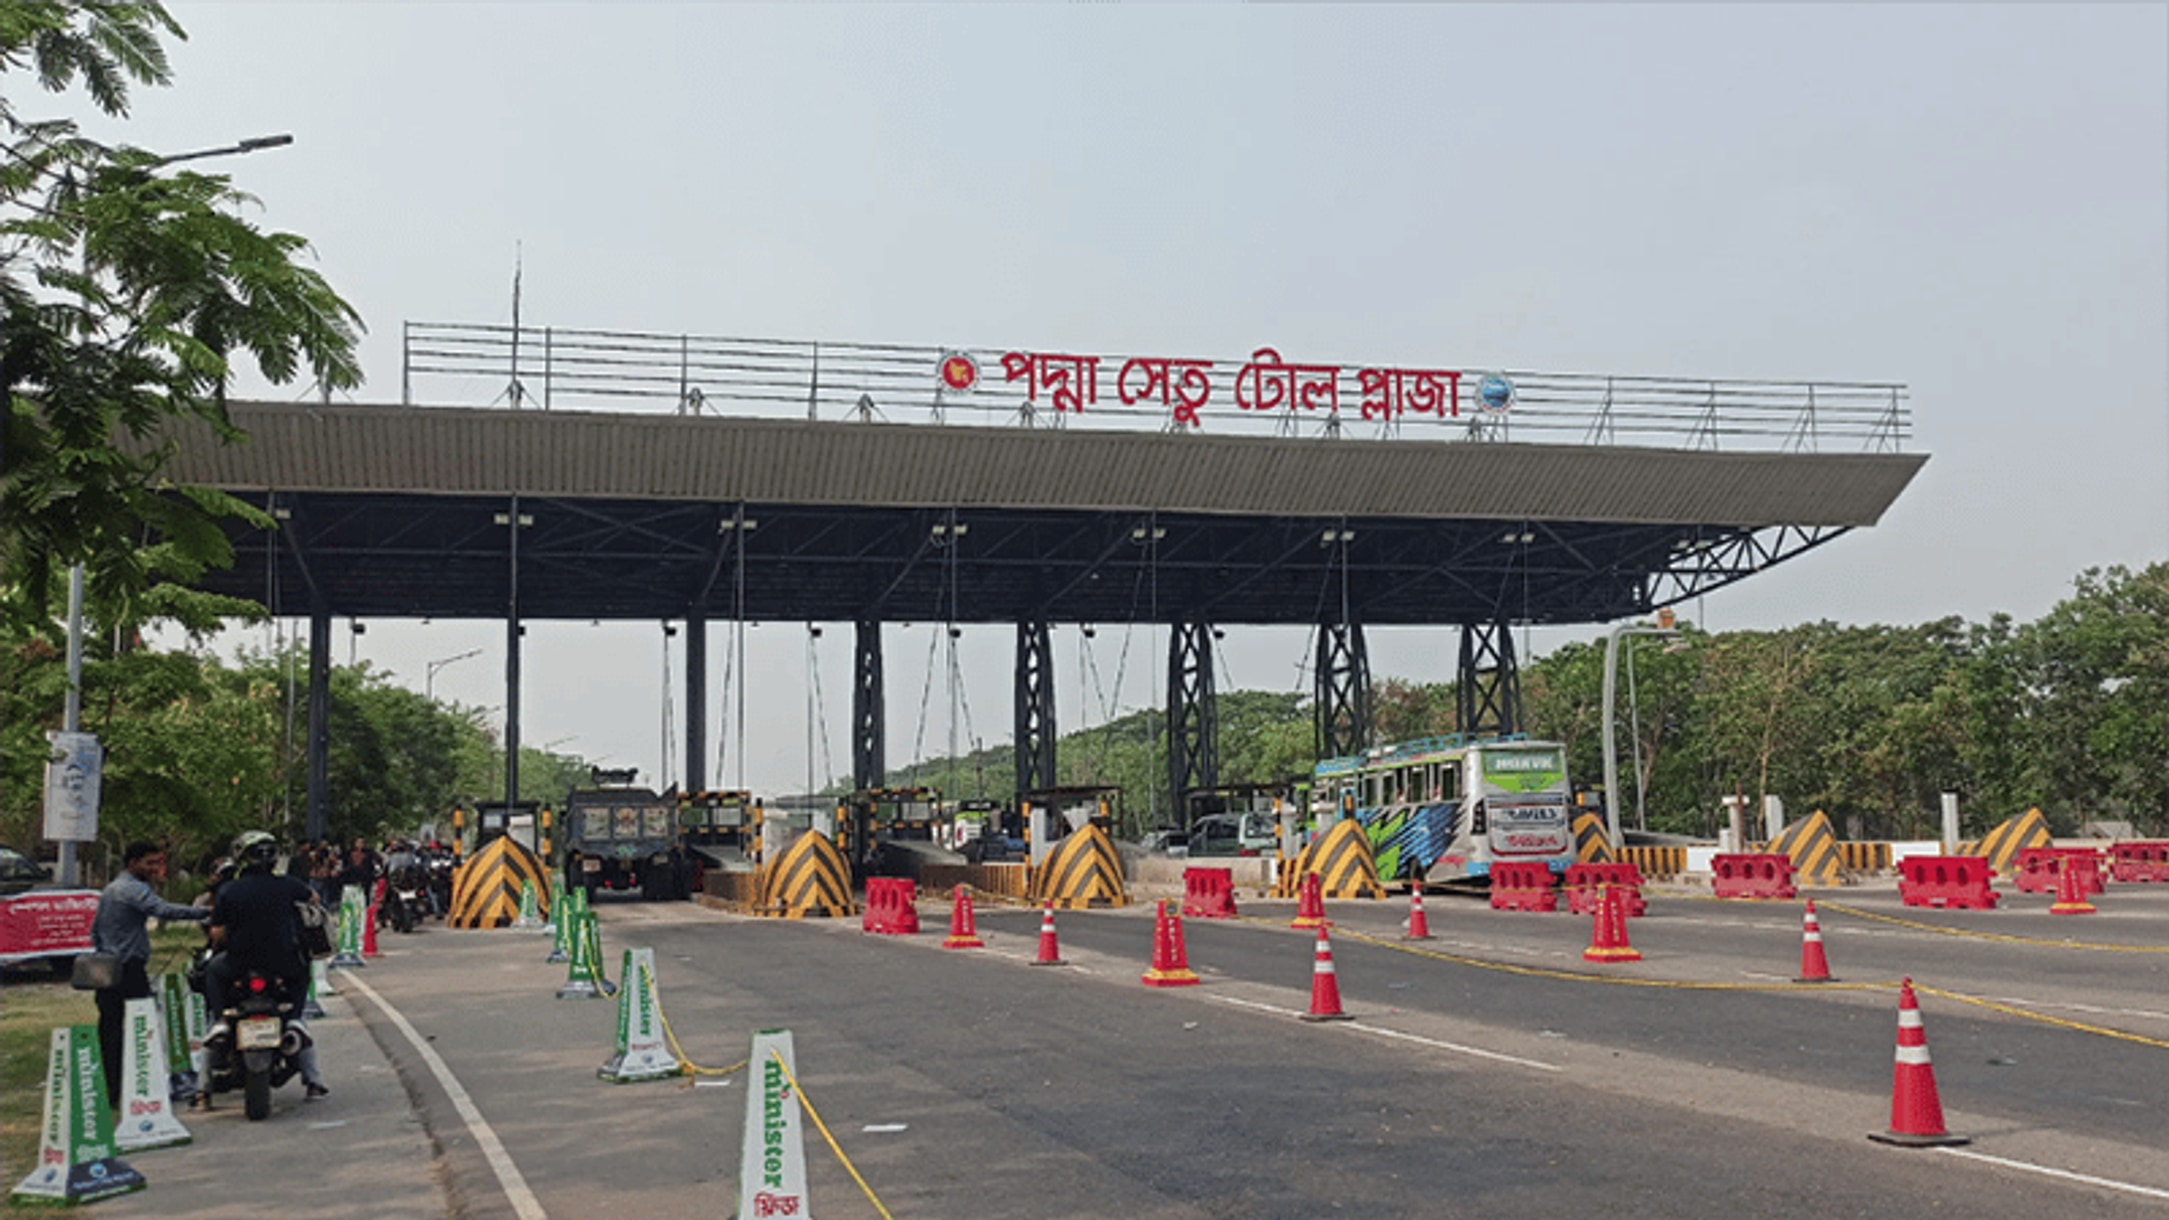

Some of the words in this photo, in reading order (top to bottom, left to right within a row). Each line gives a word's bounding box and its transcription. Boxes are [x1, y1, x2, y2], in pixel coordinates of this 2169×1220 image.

[1000, 351, 1100, 414] পদ্মা
[1117, 357, 1213, 427] সেতু
[1235, 347, 1340, 412] টোল
[1357, 367, 1462, 422] প্লাজা
[77, 1045, 99, 1140] minister
[132, 1014, 154, 1097] minister
[764, 1059, 790, 1188] minister
